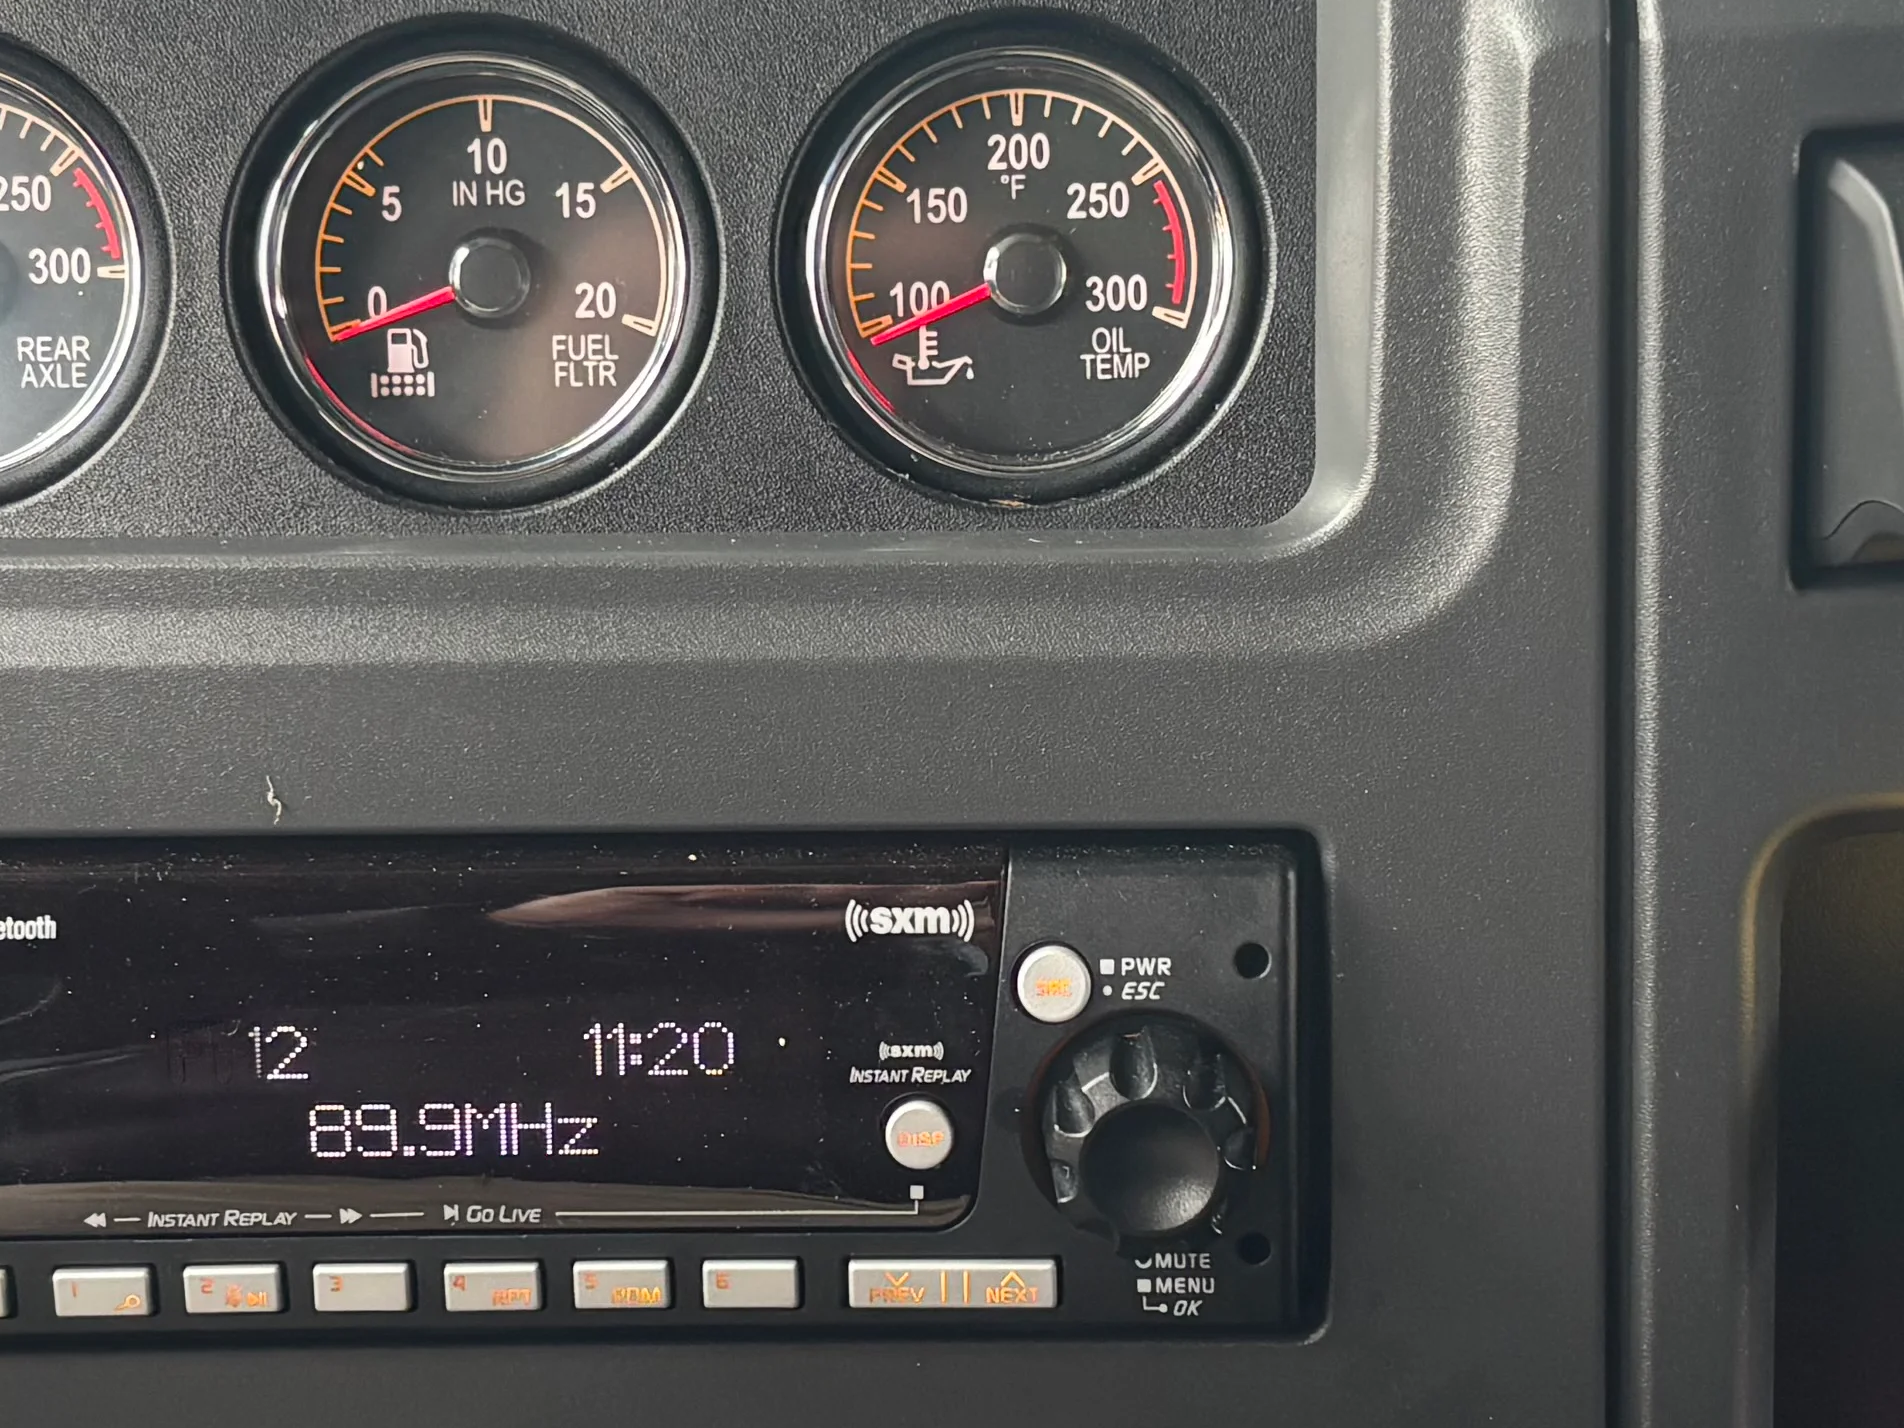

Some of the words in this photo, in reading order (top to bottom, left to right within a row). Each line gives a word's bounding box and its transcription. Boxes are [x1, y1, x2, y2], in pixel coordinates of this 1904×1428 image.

[466, 138, 508, 174] 10
[987, 132, 1050, 171] 200
[381, 186, 402, 222] 5
[452, 180, 477, 207] IN
[485, 180, 525, 207] HG
[555, 182, 596, 219] 15
[906, 187, 967, 224] 150
[1067, 181, 1130, 219] 250
[28, 247, 91, 285] 300
[368, 285, 387, 318] 0
[575, 282, 616, 319] 20
[889, 280, 950, 318] 100
[1085, 274, 1147, 312] 300
[16, 335, 91, 362] REAR
[552, 334, 619, 362] FUEL
[1092, 326, 1132, 354] OIL
[20, 362, 88, 389] AXLE
[554, 361, 617, 388] FLTR
[1080, 353, 1151, 380] TEMP
[870, 906, 950, 934] sxm
[1120, 957, 1172, 977] PWR
[1121, 982, 1165, 1000] ESC
[248, 1025, 309, 1081] 12
[583, 1021, 734, 1077] 11:20
[309, 1102, 598, 1158] 89.9MHz
[1154, 1252, 1211, 1269] MUTE
[200, 1278, 214, 1294] 2
[329, 1276, 343, 1292] 3
[452, 1275, 466, 1291] 4
[716, 1272, 731, 1290] 6
[1156, 1277, 1215, 1294] MENU
[869, 1287, 926, 1304] PREV
[986, 1287, 1039, 1304] NEXT
[1173, 1300, 1202, 1317] OK
